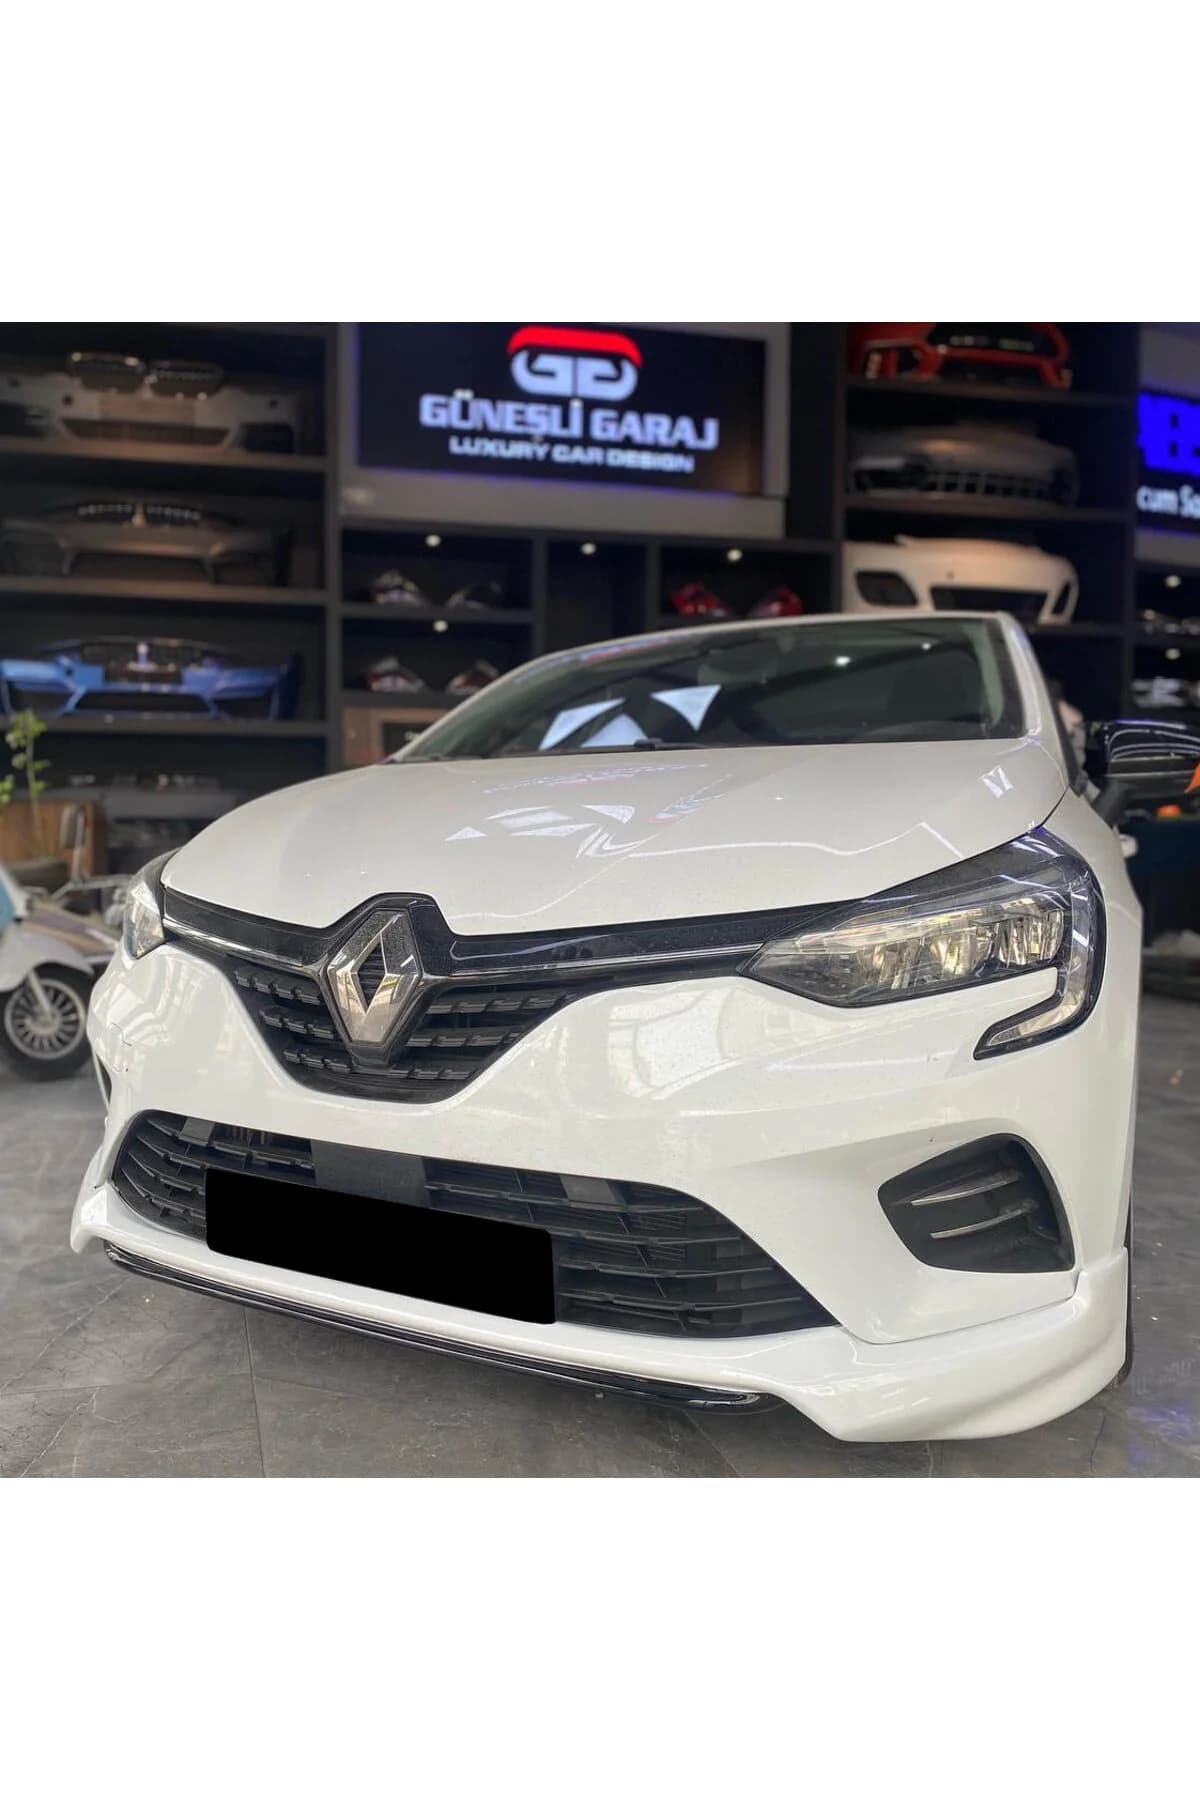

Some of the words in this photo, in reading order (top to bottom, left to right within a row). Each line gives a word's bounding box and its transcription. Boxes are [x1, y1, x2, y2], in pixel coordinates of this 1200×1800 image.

[590, 409, 719, 450] GARAJ
[449, 435, 549, 461] LUXURY
[551, 447, 604, 467] CAR
[606, 450, 696, 473] DESIGN
